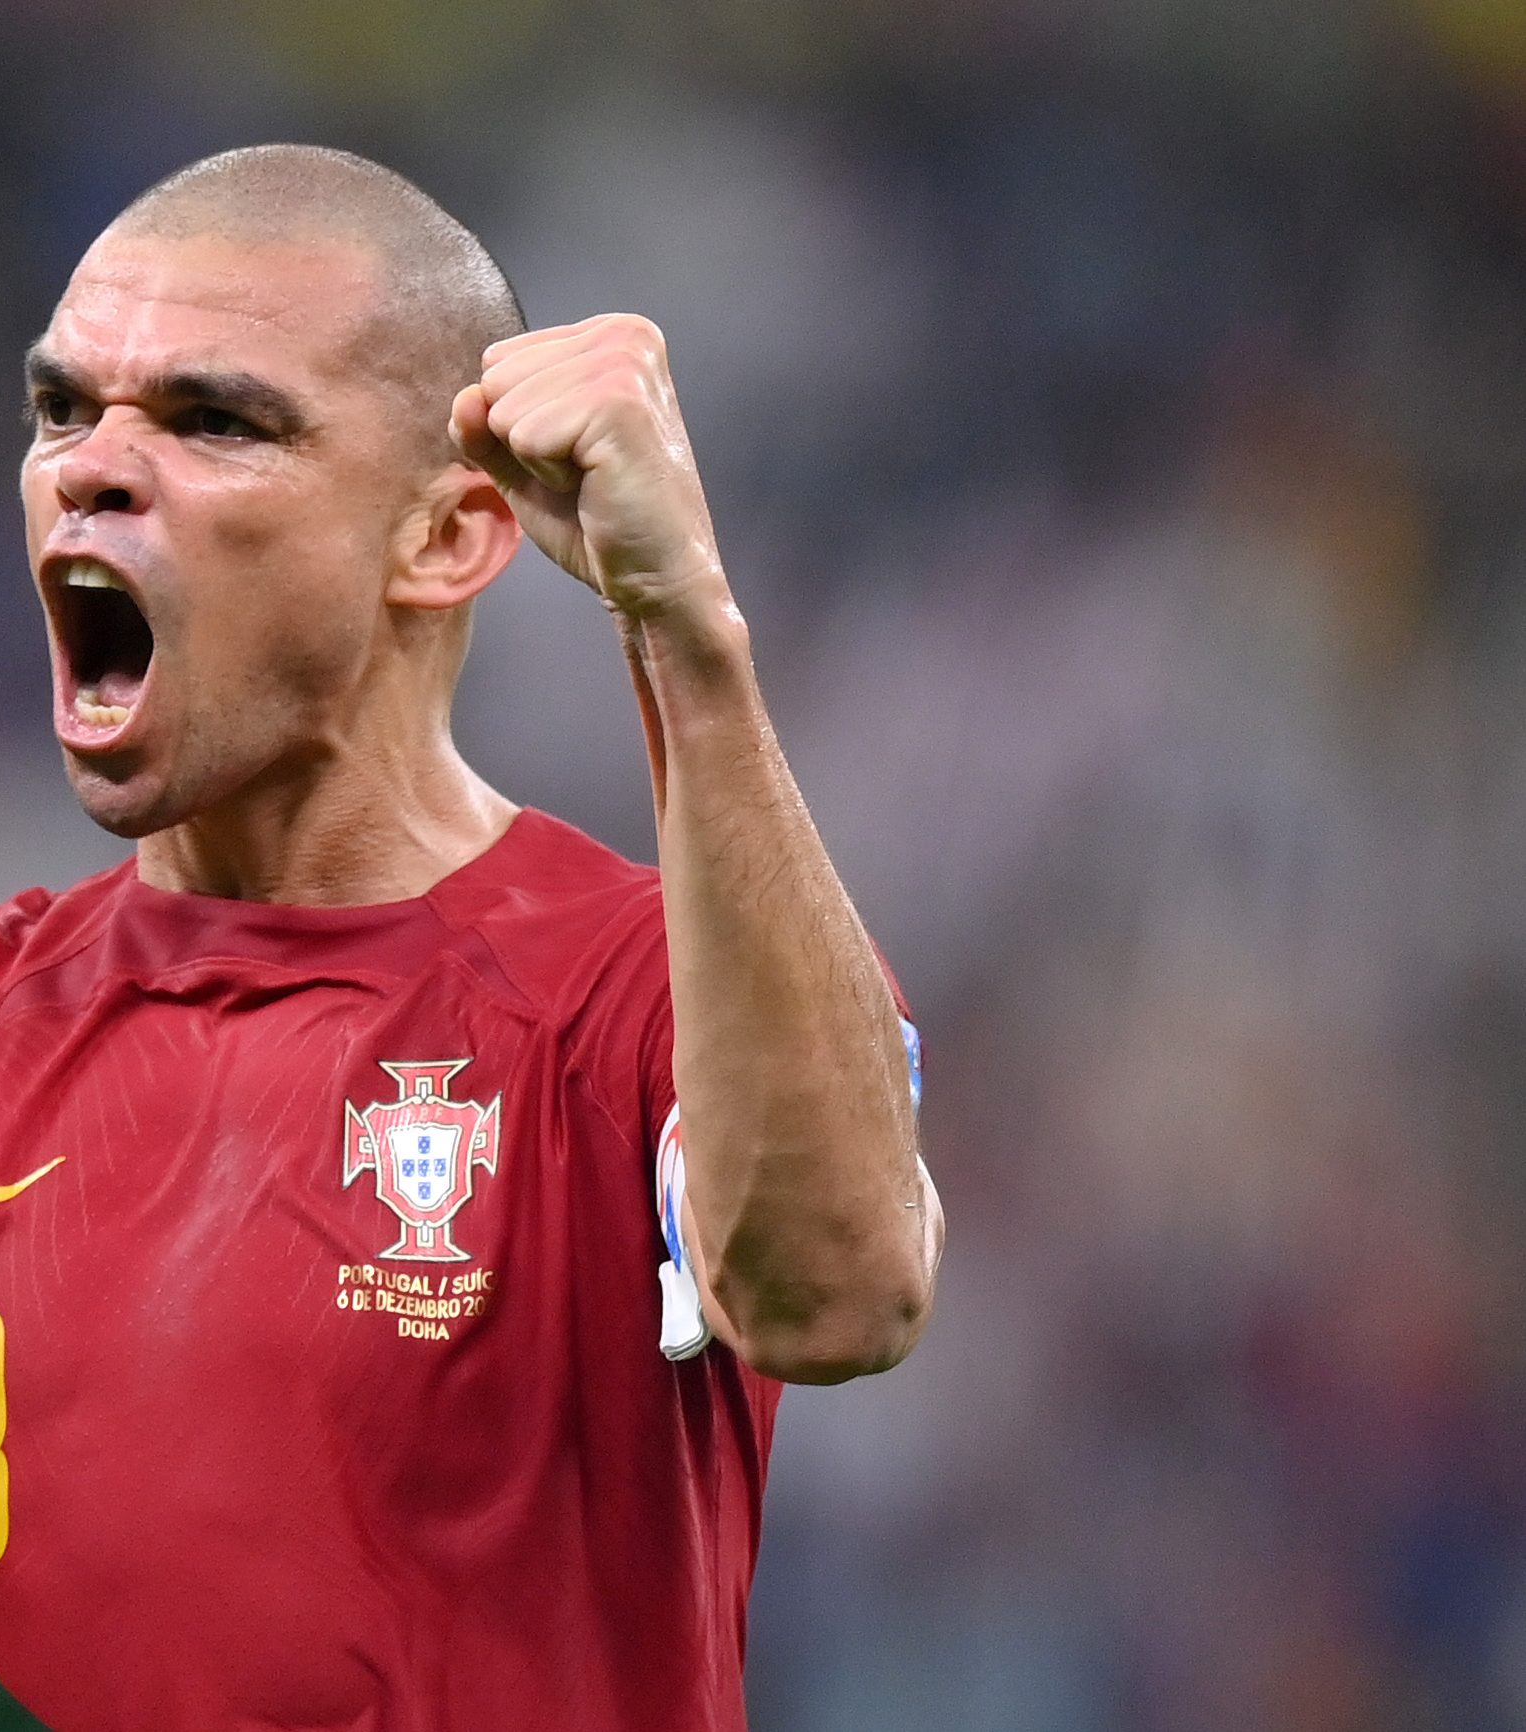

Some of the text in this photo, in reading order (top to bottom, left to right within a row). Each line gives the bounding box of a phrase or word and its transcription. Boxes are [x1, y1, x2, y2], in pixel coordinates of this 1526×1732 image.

[338, 1264, 434, 1296] PORTUGAL
[438, 1276, 448, 1297] /
[336, 1289, 349, 1310] 6
[352, 1289, 372, 1311] DE
[375, 1289, 461, 1319] DEZEMBRO
[398, 1317, 450, 1341] DOHA
